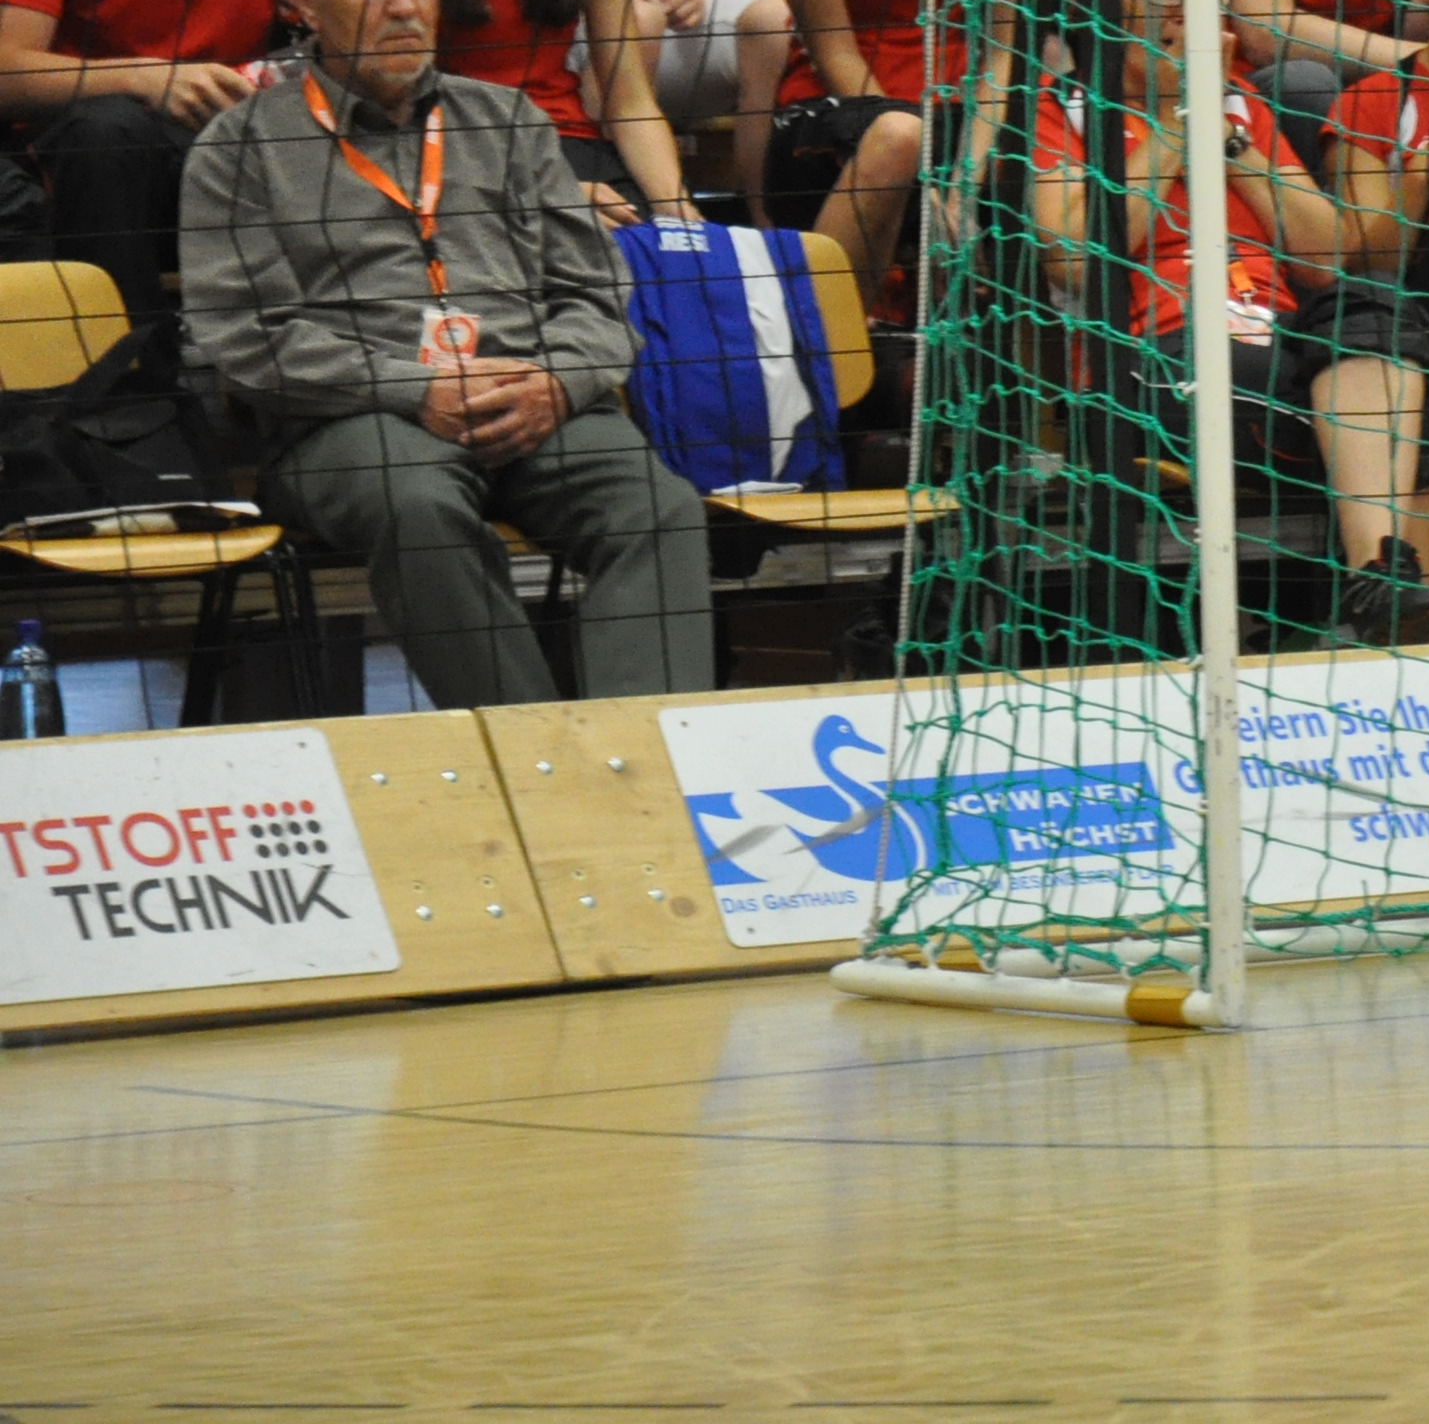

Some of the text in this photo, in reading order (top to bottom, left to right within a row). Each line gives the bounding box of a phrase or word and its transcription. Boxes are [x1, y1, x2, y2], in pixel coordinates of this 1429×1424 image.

[1237, 702, 1328, 744] eiern
[1338, 698, 1393, 736] Sie
[1171, 750, 1341, 795] Gthaus
[1349, 744, 1412, 784] mit
[943, 782, 1150, 819] SCHWANEN
[1011, 817, 1161, 855] HÖCHST
[53, 863, 352, 941] TECHNIK
[762, 888, 859, 913] GASTHAUS
